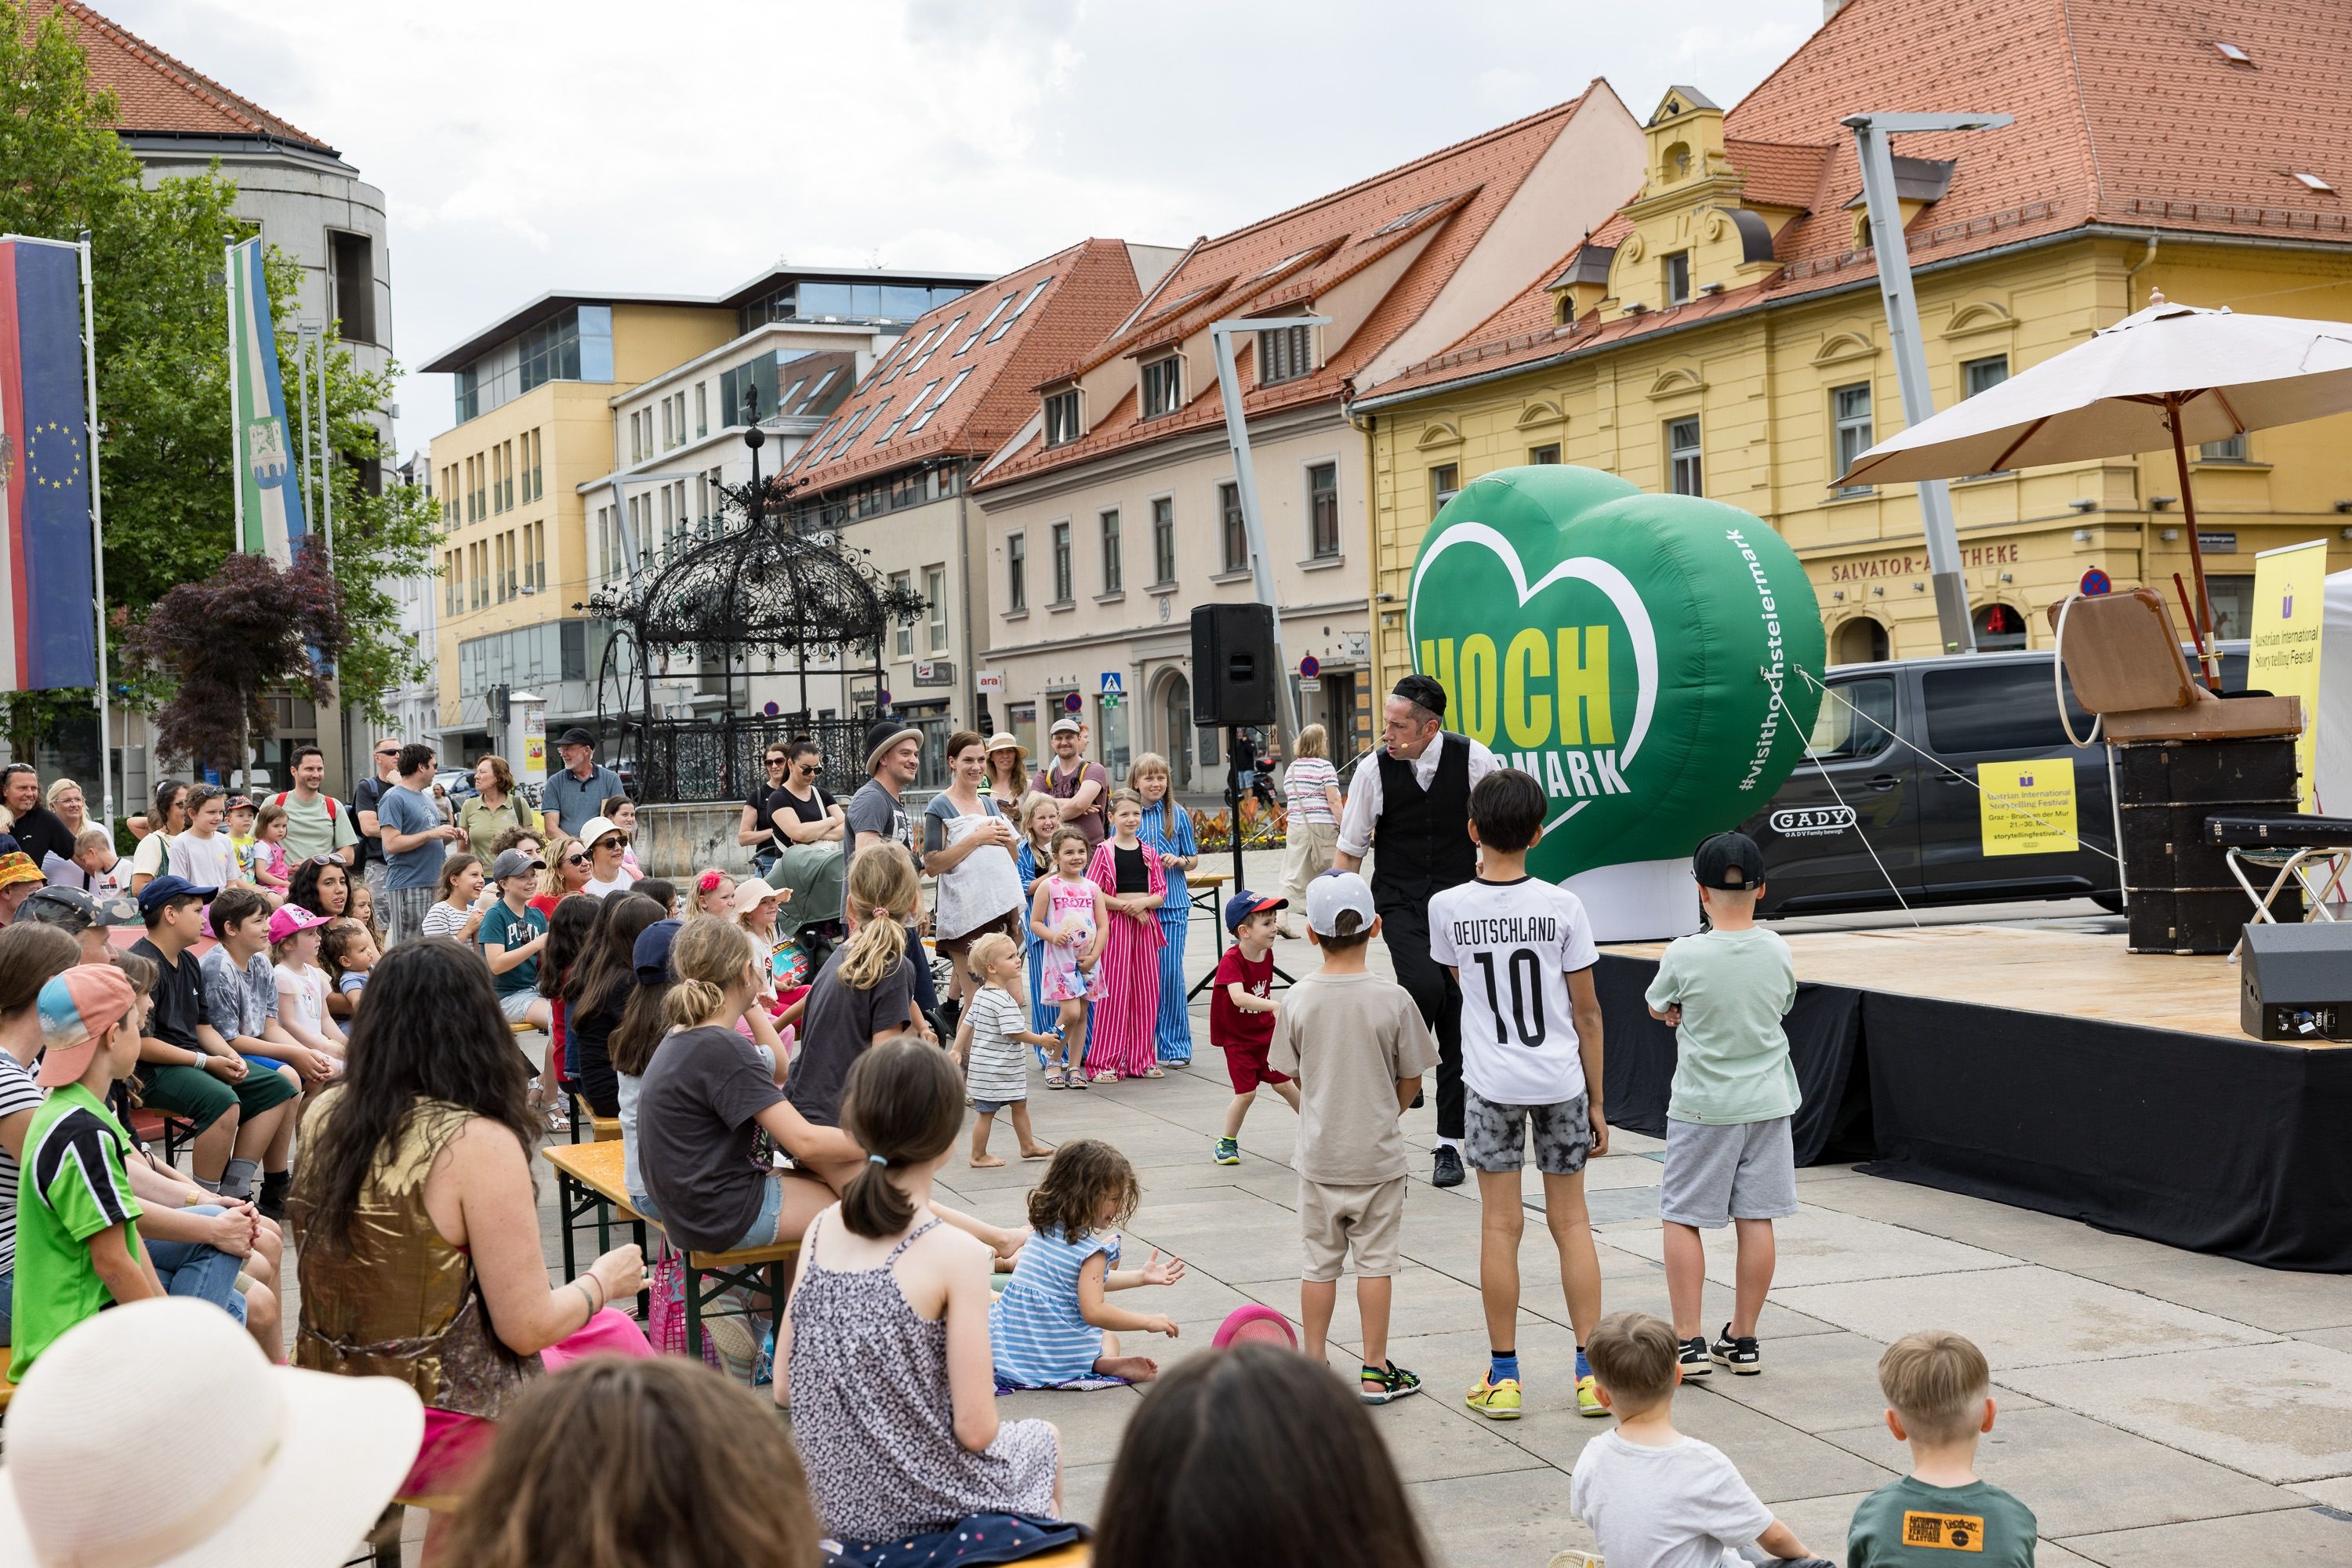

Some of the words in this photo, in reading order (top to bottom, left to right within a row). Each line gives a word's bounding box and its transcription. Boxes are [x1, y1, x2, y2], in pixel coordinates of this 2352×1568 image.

[1832, 543, 2019, 582] SALVATOR-ATHEKE
[2255, 631, 2280, 648] Austrian
[2281, 626, 2318, 644] International
[1726, 528, 1784, 791] #visithochsteiermark
[2255, 650, 2290, 670] Storytelling
[2290, 648, 2314, 665] Festival
[980, 677, 998, 685] ara
[1421, 625, 1616, 749] HOCH
[2021, 789, 2071, 798] International
[2038, 798, 2069, 807] Festival
[1780, 810, 1846, 828] GADY
[1454, 916, 1555, 946] DEUTSCHLAND
[1473, 948, 1546, 1047] 10
